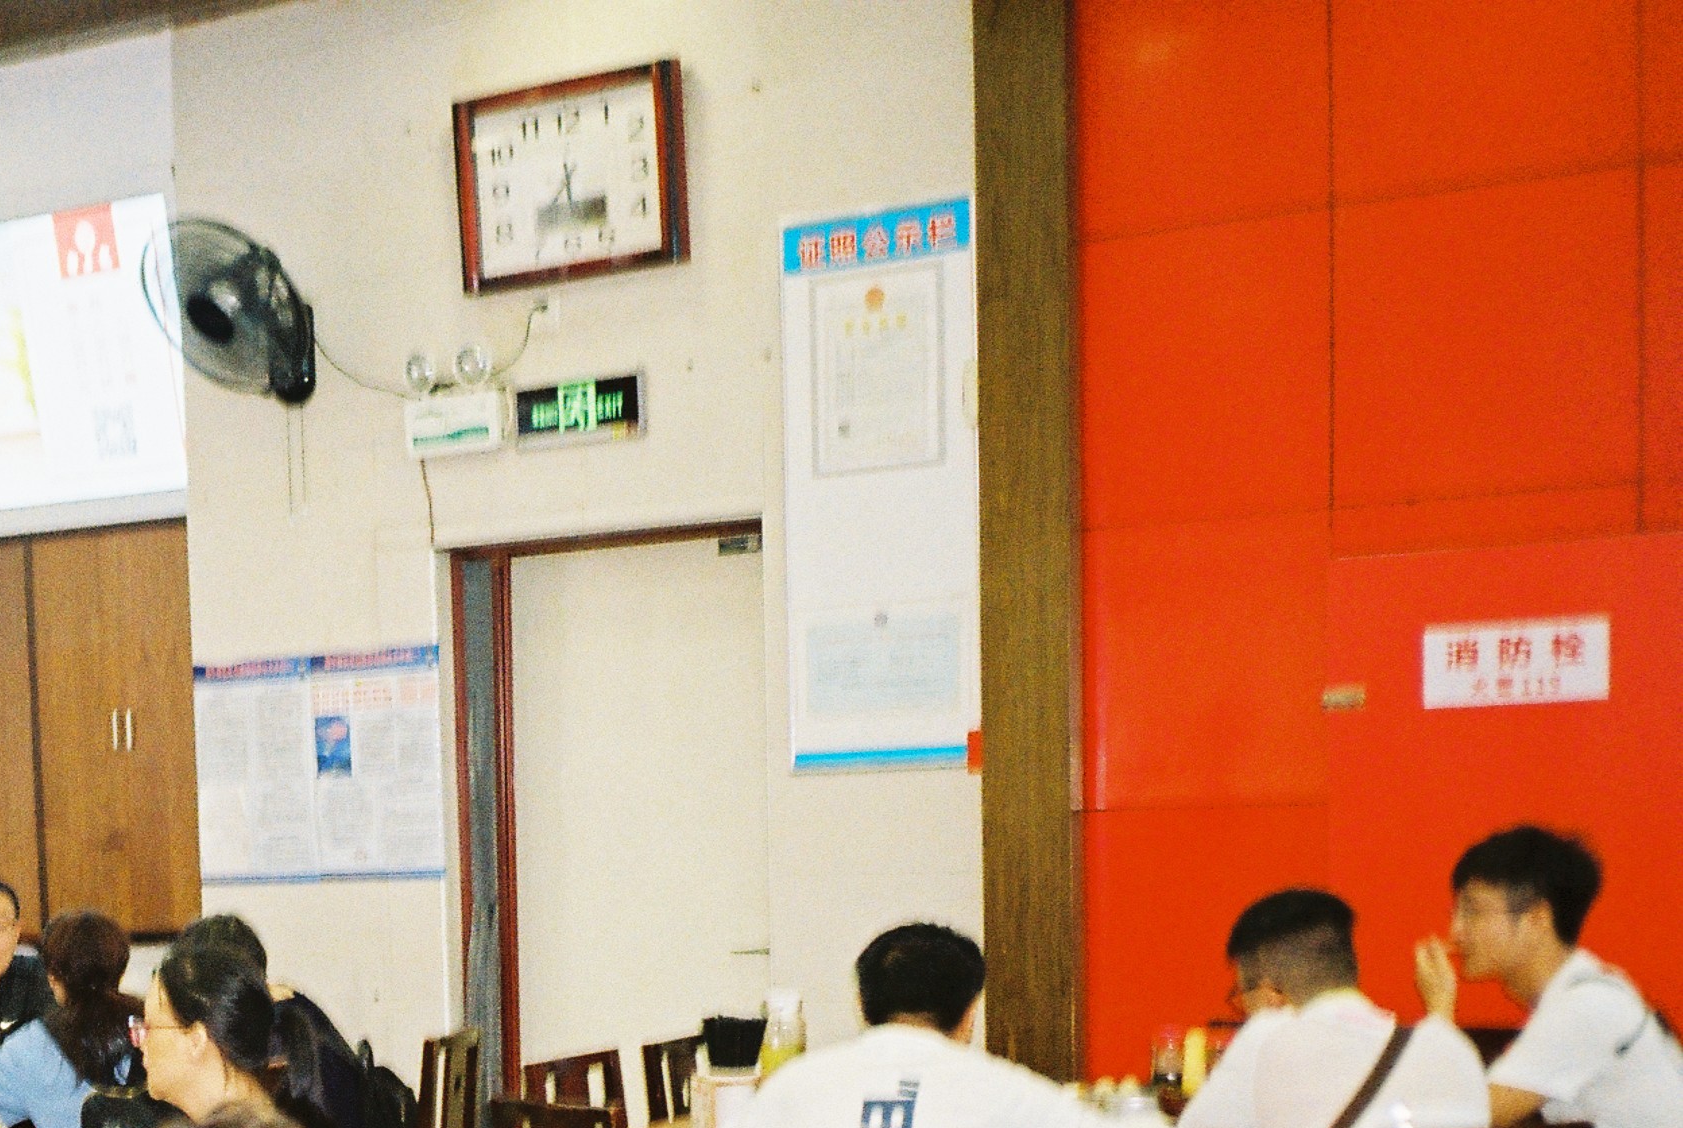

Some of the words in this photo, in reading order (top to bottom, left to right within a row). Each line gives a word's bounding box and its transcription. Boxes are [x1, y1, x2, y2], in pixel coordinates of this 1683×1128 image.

[799, 212, 957, 270] 证照公示栏
[1445, 633, 1585, 672] 消防栓
